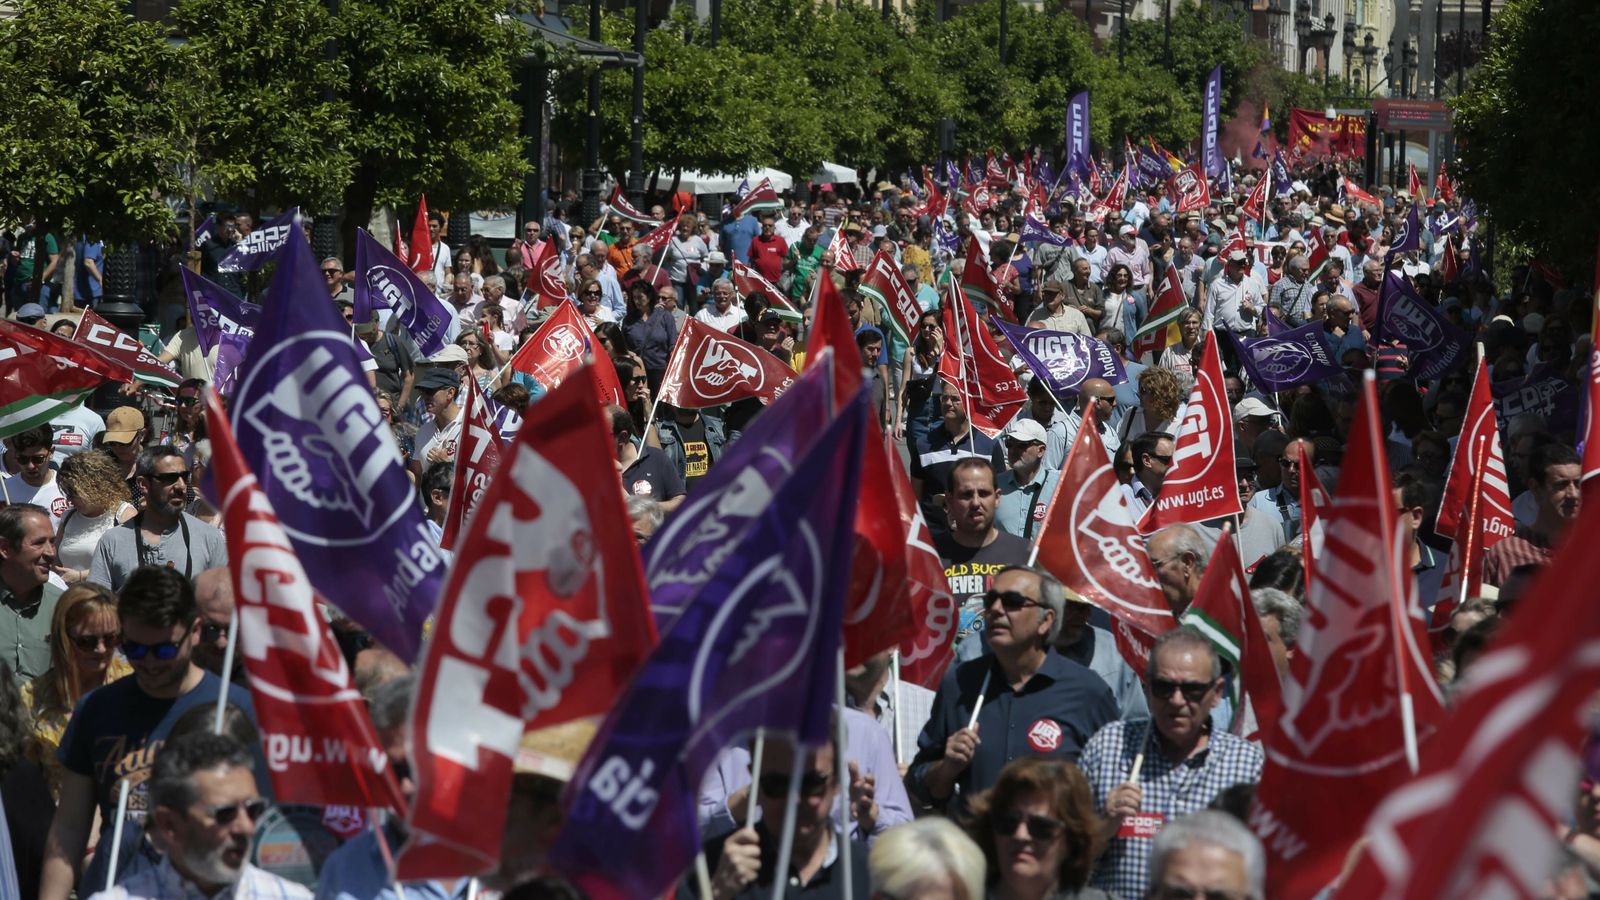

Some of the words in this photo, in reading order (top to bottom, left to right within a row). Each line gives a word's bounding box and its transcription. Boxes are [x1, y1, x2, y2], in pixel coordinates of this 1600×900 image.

[1073, 104, 1082, 160] CCO
[876, 258, 920, 327] CCOO
[1028, 335, 1077, 359] UGT
[272, 346, 404, 493] UGT
[944, 564, 969, 577] OLD
